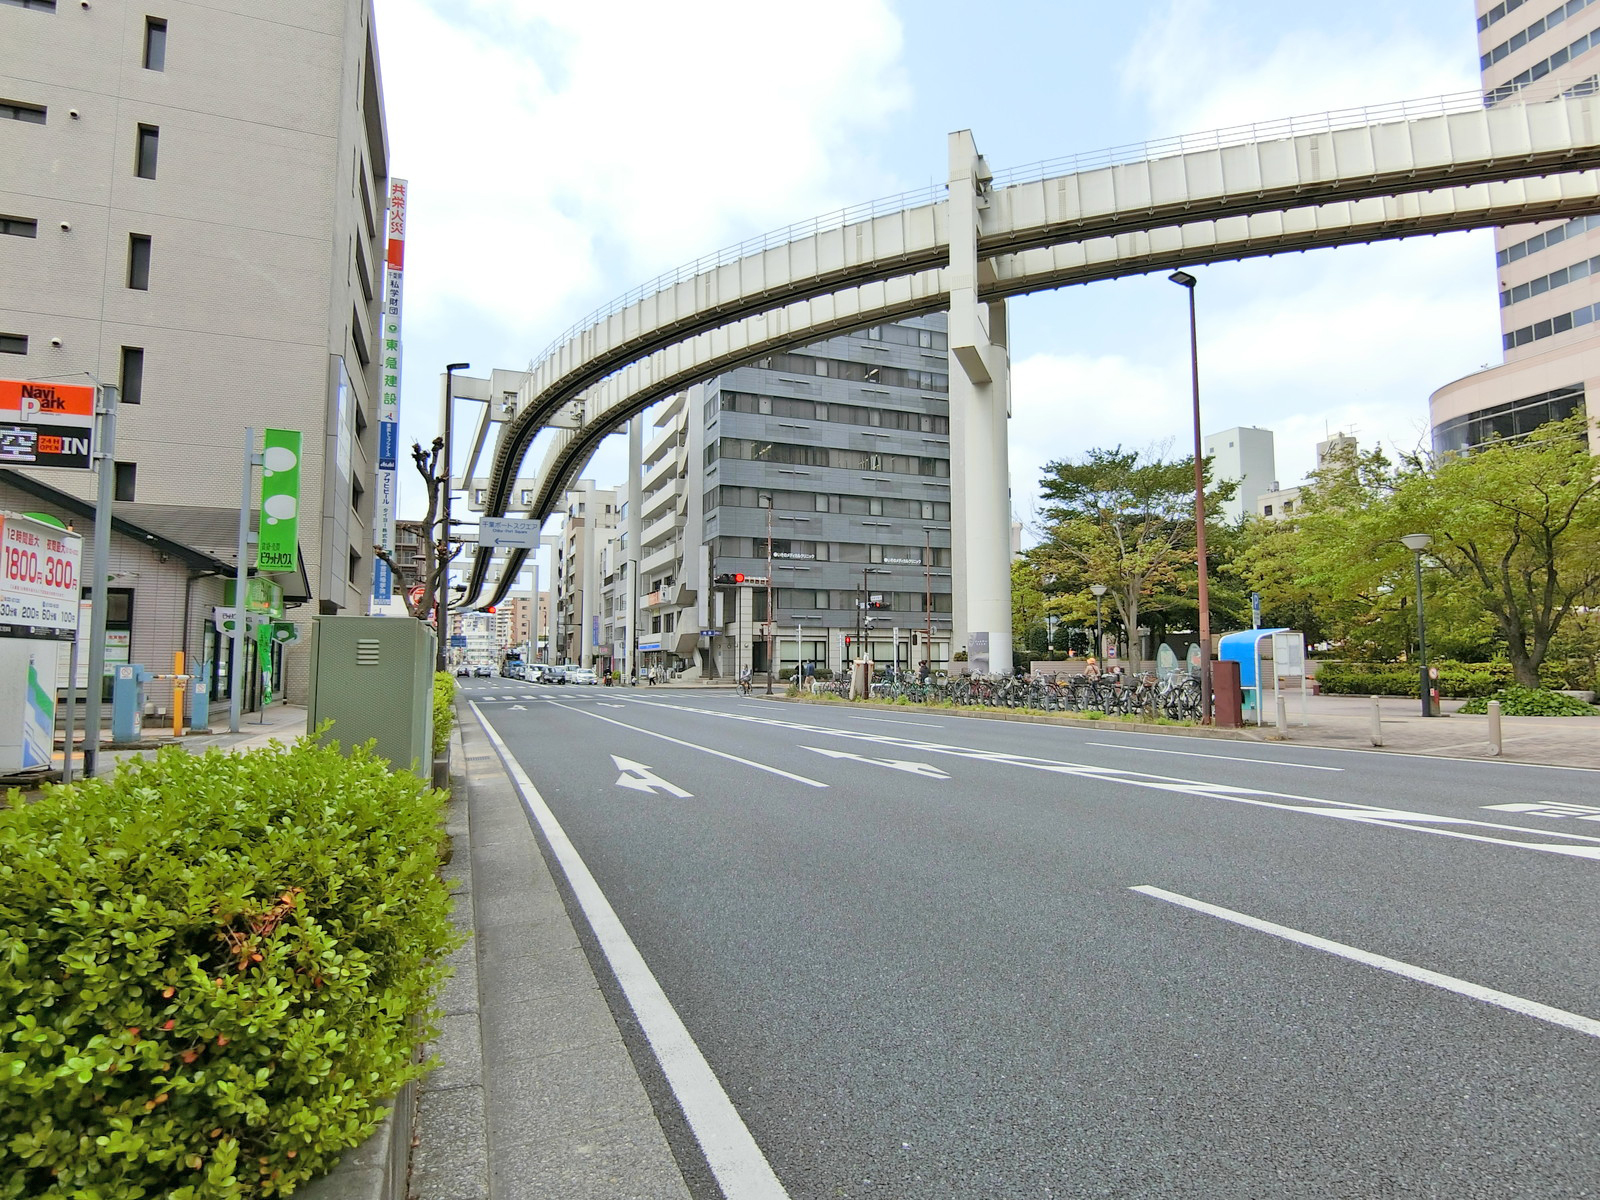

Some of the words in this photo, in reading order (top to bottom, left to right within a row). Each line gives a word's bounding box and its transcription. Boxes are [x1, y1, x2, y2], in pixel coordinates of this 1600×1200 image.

[391, 183, 406, 235] 共栄火災
[388, 280, 400, 315] 私学財団
[383, 338, 398, 406] 東急建設
[21, 385, 56, 399] Navi
[21, 397, 65, 421] Park
[40, 444, 60, 452] OPEN
[62, 437, 88, 455] IN
[382, 472, 391, 505] アサヒビール
[260, 552, 292, 564] ピタットハウス
